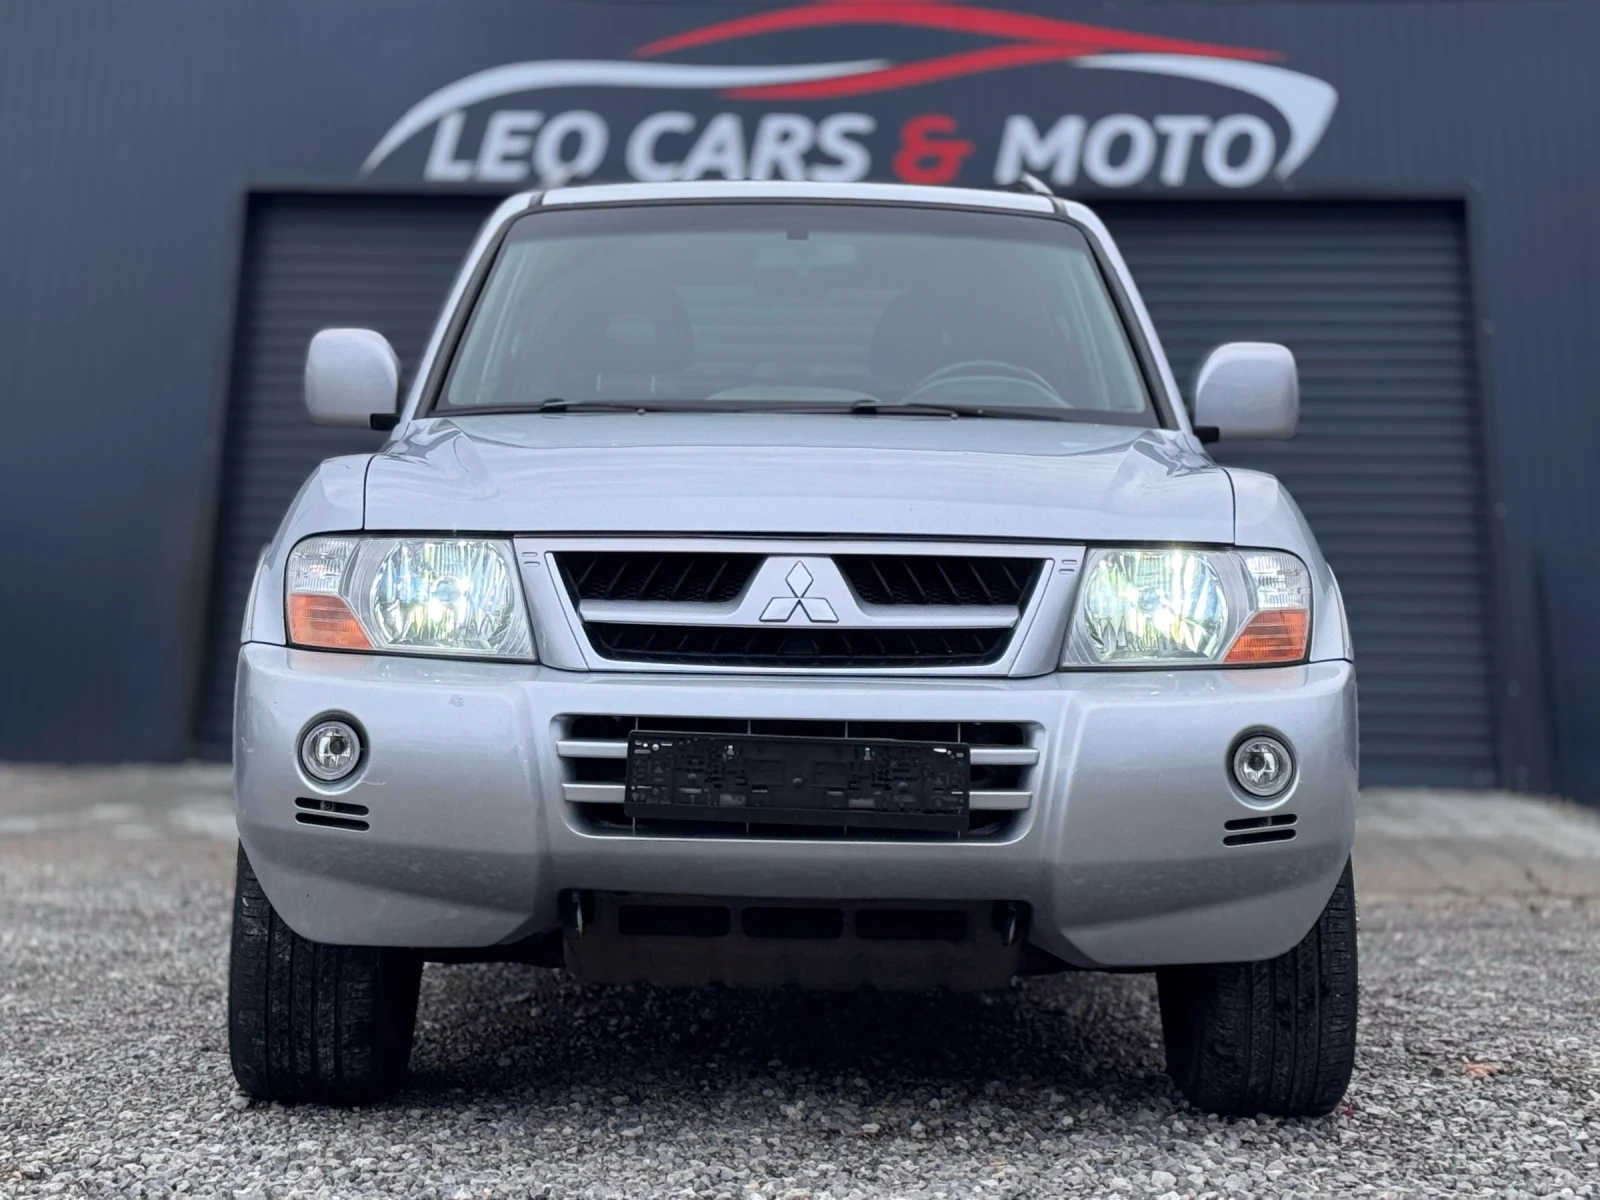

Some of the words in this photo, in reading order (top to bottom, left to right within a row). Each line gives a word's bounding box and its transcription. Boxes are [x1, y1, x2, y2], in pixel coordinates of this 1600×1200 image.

[423, 109, 610, 183] LEO
[625, 112, 876, 183] CARS
[892, 114, 976, 185] &
[994, 113, 1277, 188] MOTO
